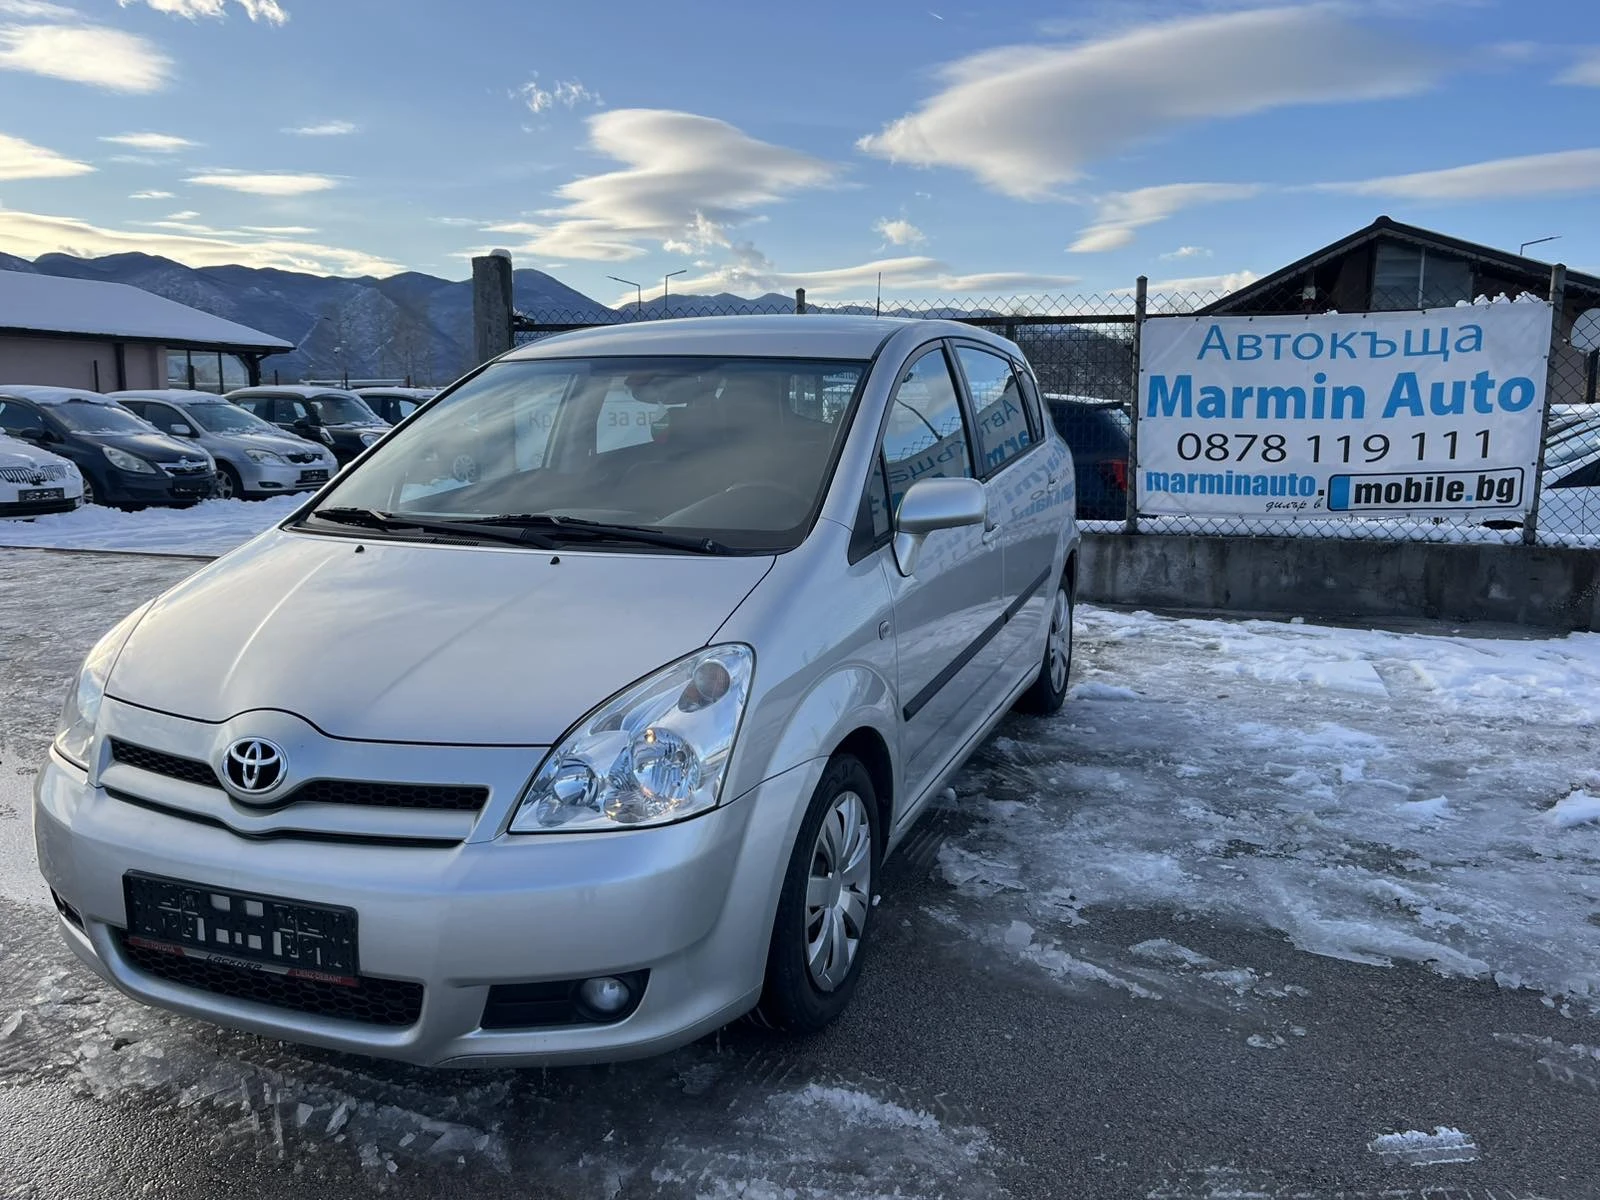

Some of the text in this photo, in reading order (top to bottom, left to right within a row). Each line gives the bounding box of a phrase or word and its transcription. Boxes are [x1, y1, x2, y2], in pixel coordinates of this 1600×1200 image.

[1197, 324, 1483, 362] Автокъща
[1146, 370, 1536, 420] Marmin Auto
[1176, 429, 1491, 463] 0878 119 111
[1146, 469, 1516, 506] marminauto. mobile.bg
